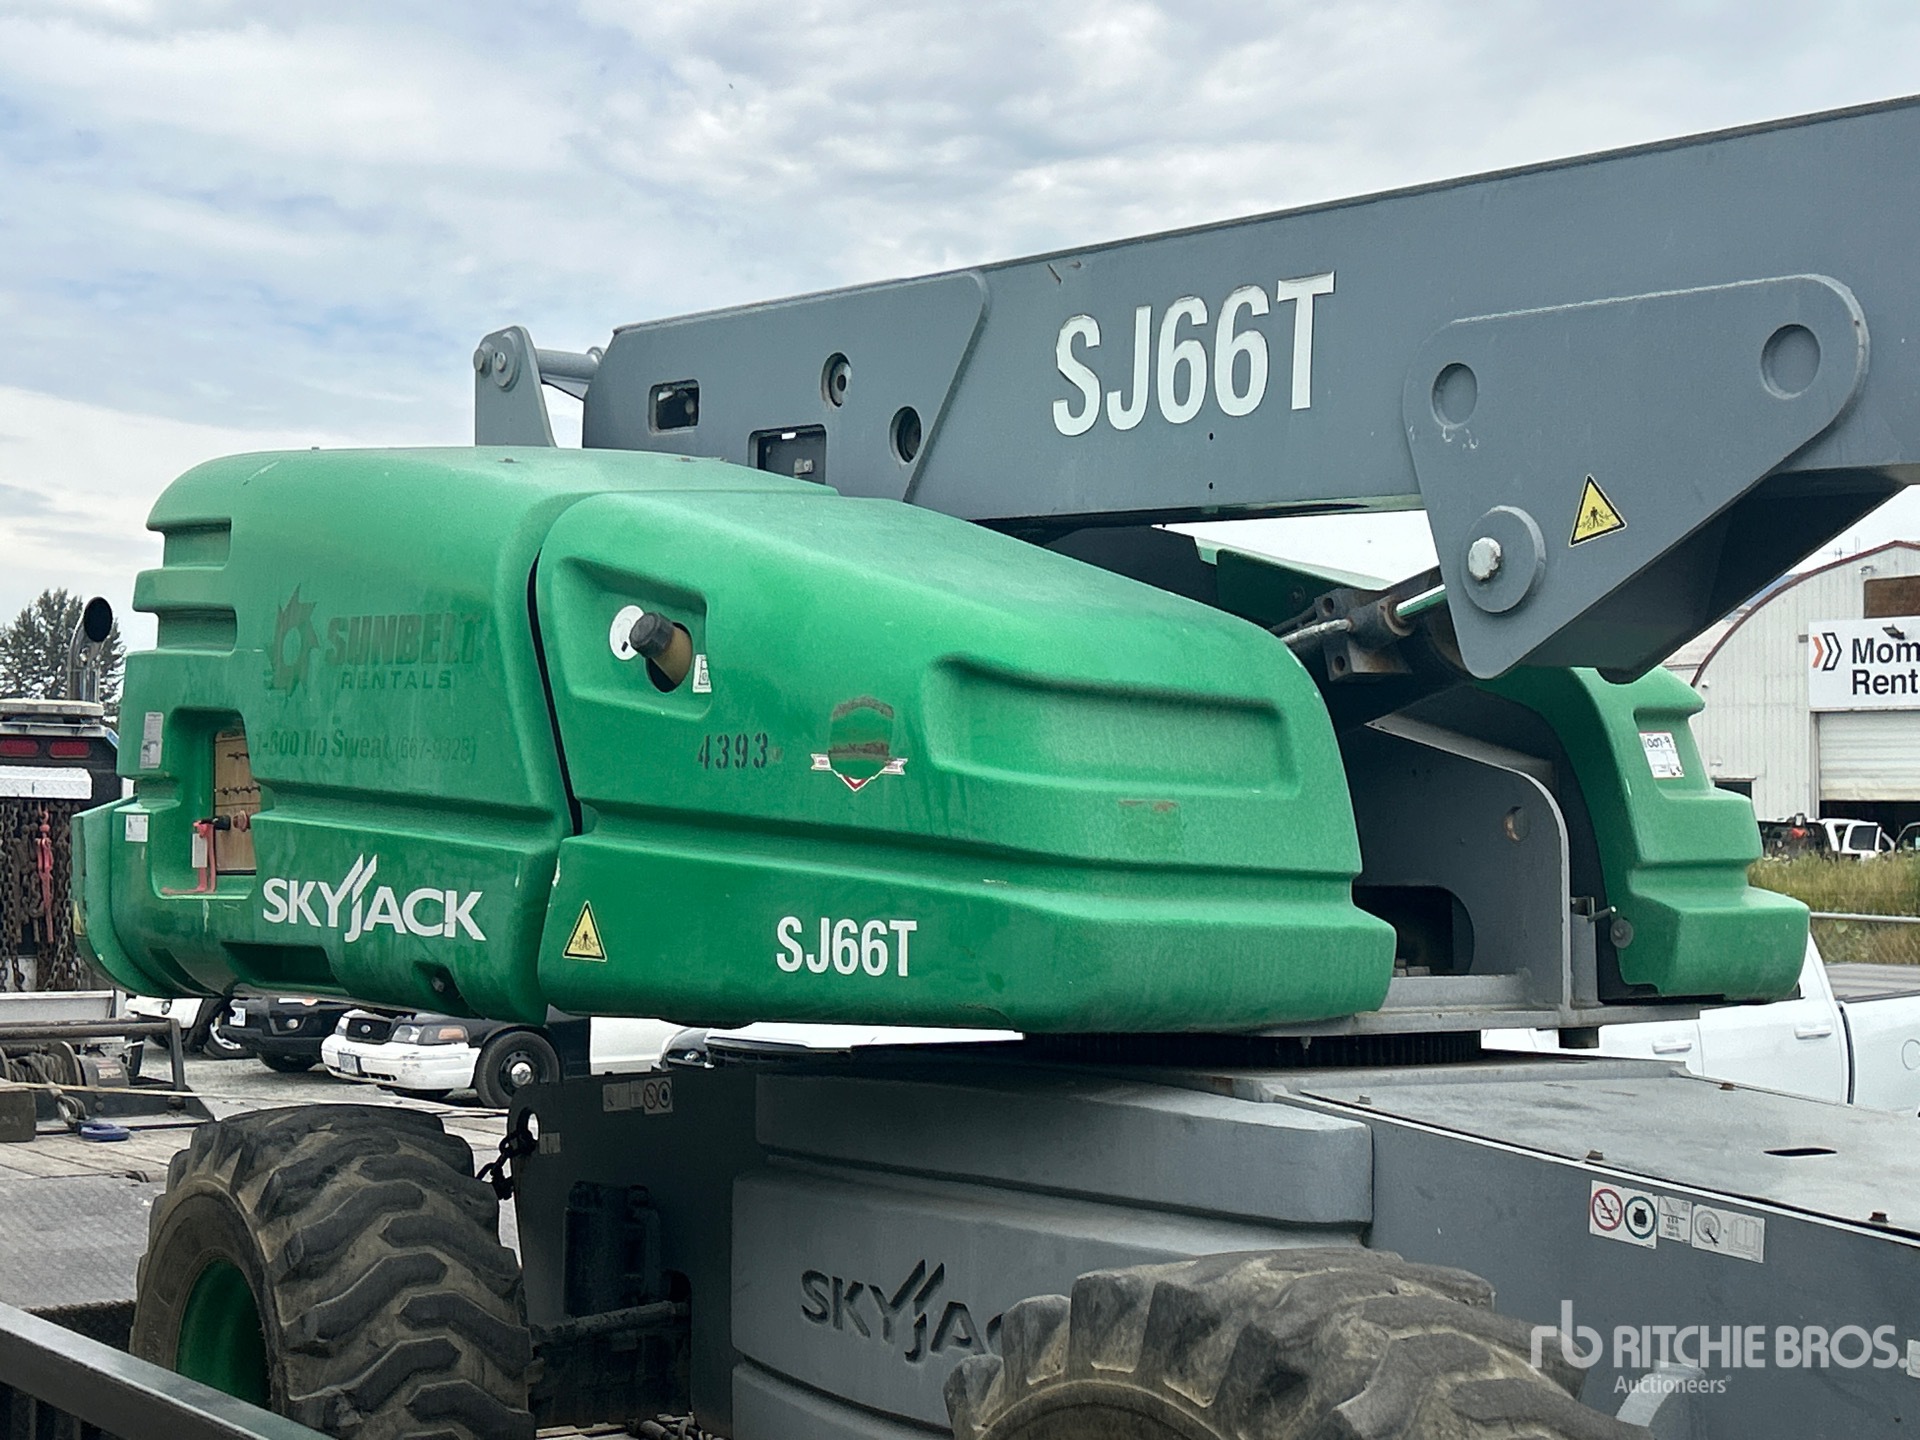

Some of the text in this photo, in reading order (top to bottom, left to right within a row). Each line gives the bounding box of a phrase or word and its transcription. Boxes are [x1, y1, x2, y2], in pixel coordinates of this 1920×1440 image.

[1053, 271, 1335, 436] SJ66T
[325, 613, 484, 666] SUNBELT
[341, 670, 452, 690] RENTALS
[698, 732, 768, 770] 4393
[263, 853, 487, 943] SKYJACK
[776, 916, 917, 977] SJ66T
